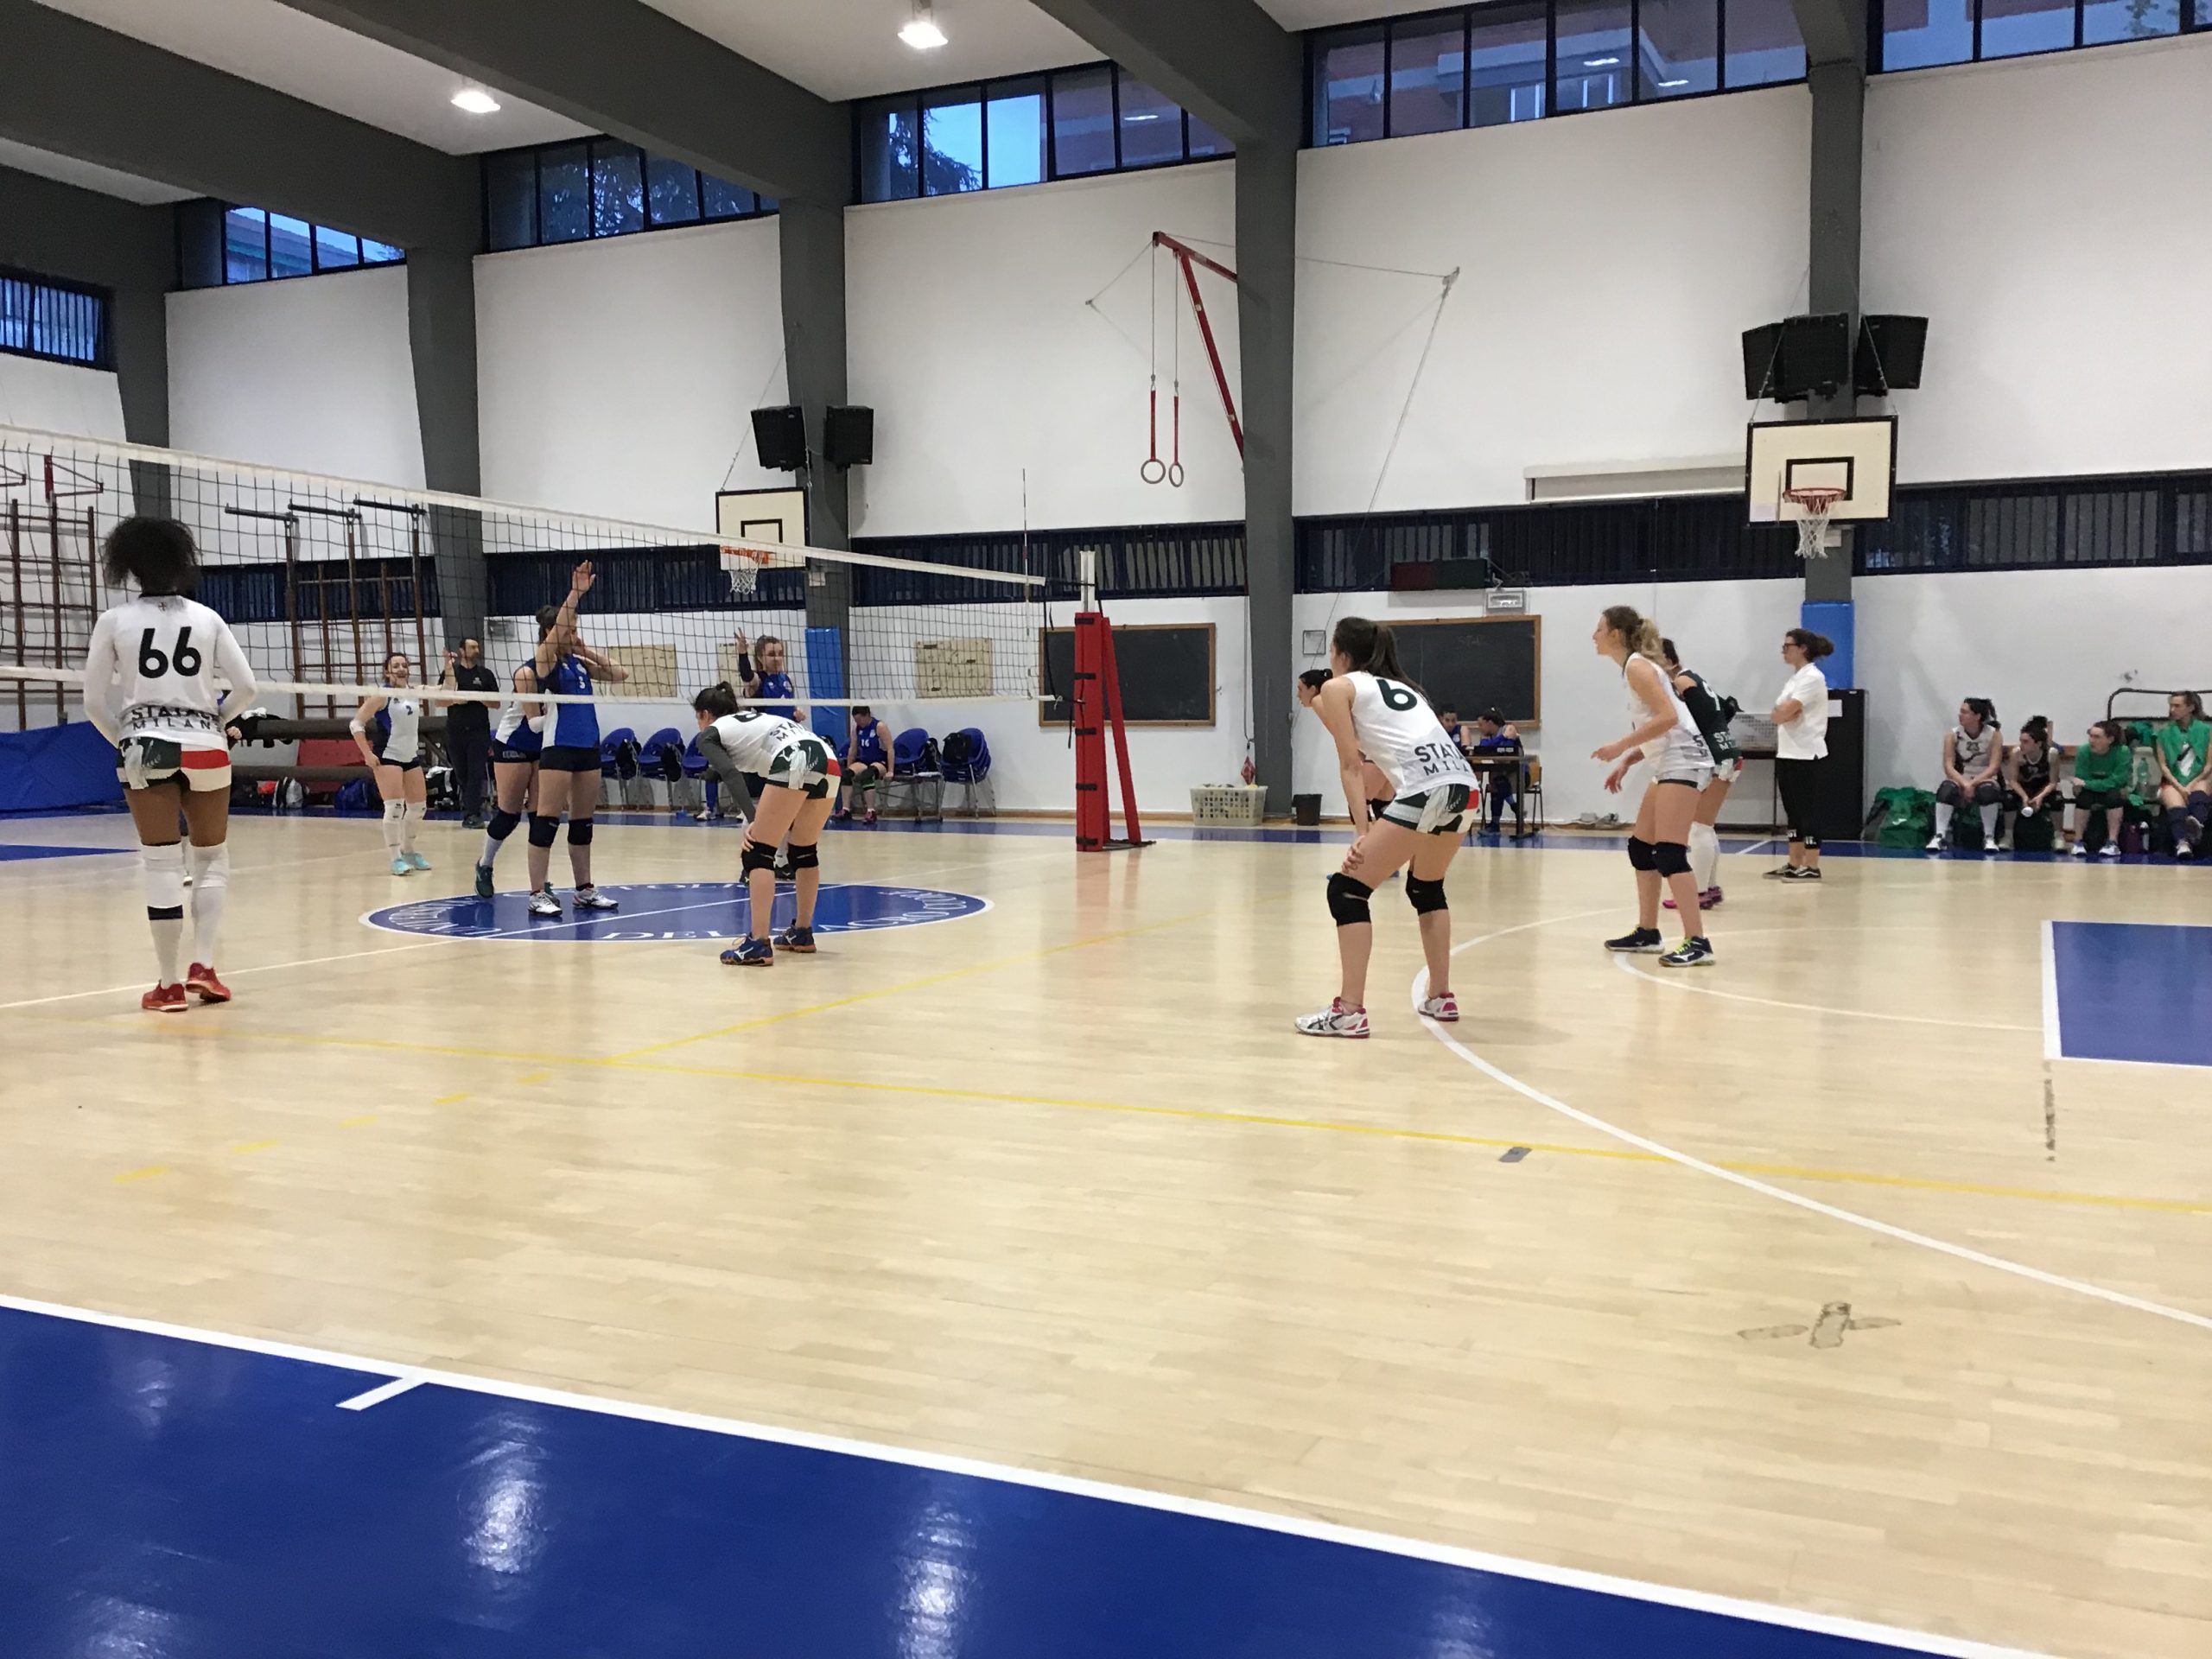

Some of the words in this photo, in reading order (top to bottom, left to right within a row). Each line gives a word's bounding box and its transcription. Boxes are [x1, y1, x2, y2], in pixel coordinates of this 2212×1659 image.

[138, 626, 201, 678] 66
[578, 676, 586, 690] 3
[1376, 679, 1417, 711] 6
